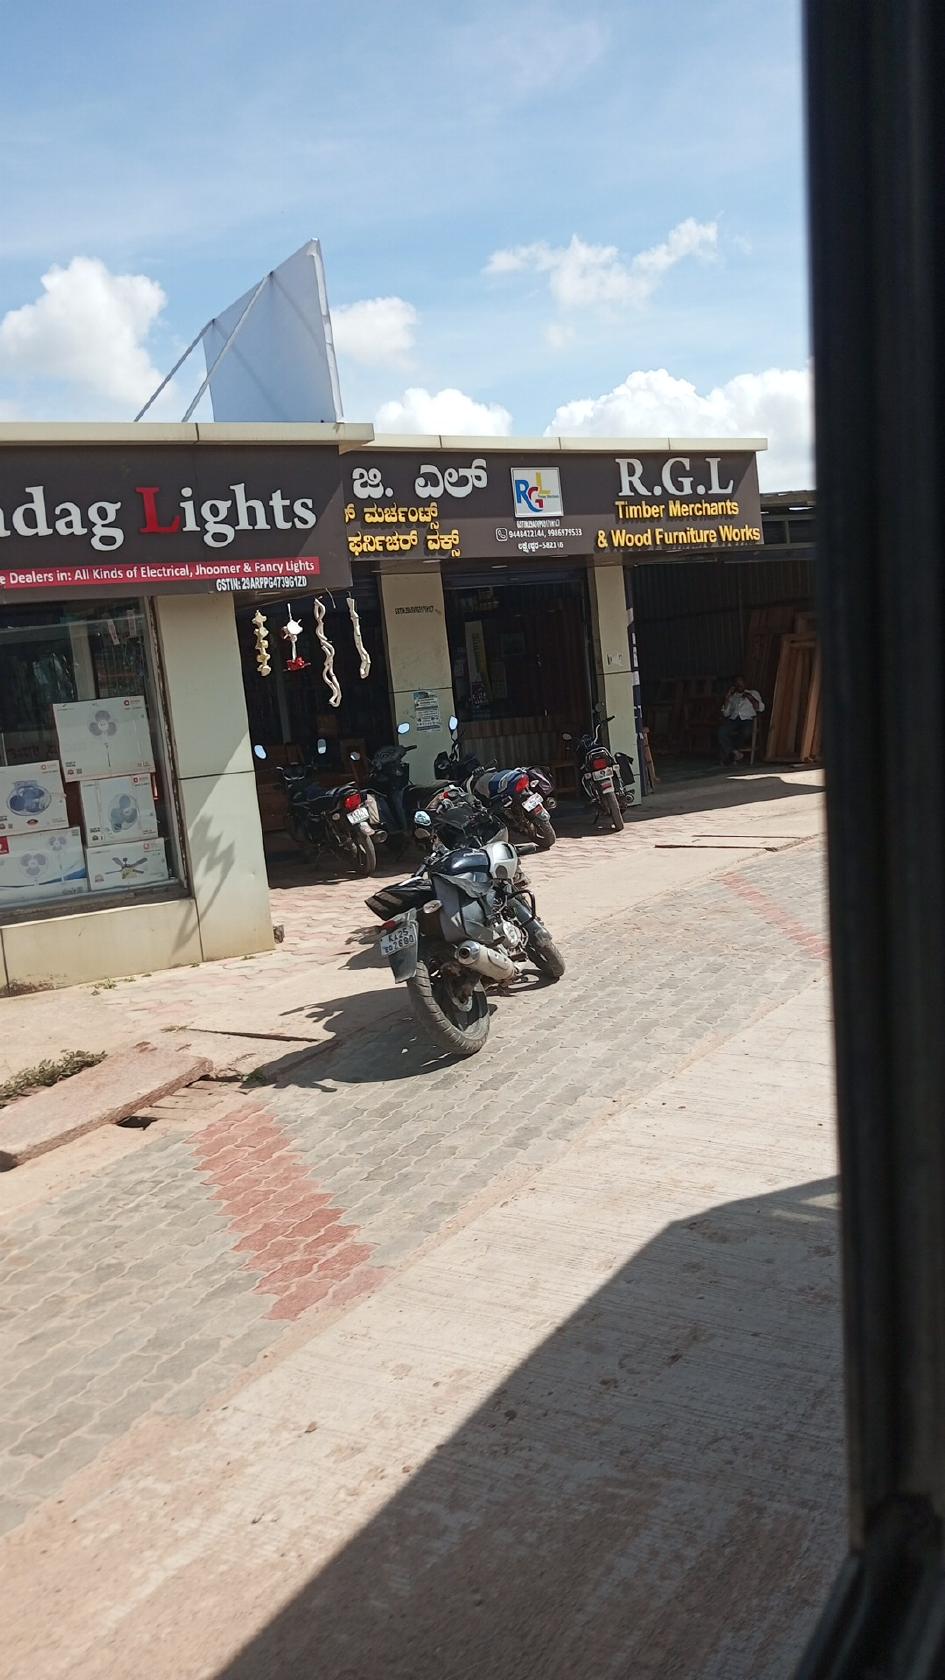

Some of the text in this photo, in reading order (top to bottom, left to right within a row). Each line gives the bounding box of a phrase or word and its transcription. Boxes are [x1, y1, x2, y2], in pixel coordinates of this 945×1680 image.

[615, 457, 735, 496] R.G.L
[135, 482, 318, 549] Lights
[615, 498, 740, 519] Timber Merchants
[597, 525, 761, 549] & Wood Furniture Works
[9, 570, 54, 585] Dealers
[56, 570, 72, 582] in:
[74, 568, 90, 581] All
[93, 567, 124, 581] Kinds
[126, 567, 138, 579] of
[140, 564, 193, 578] Electrical,
[195, 562, 241, 576] Jhoomer
[243, 562, 252, 574] &
[254, 560, 284, 575] Fancy
[285, 559, 315, 575] Lights
